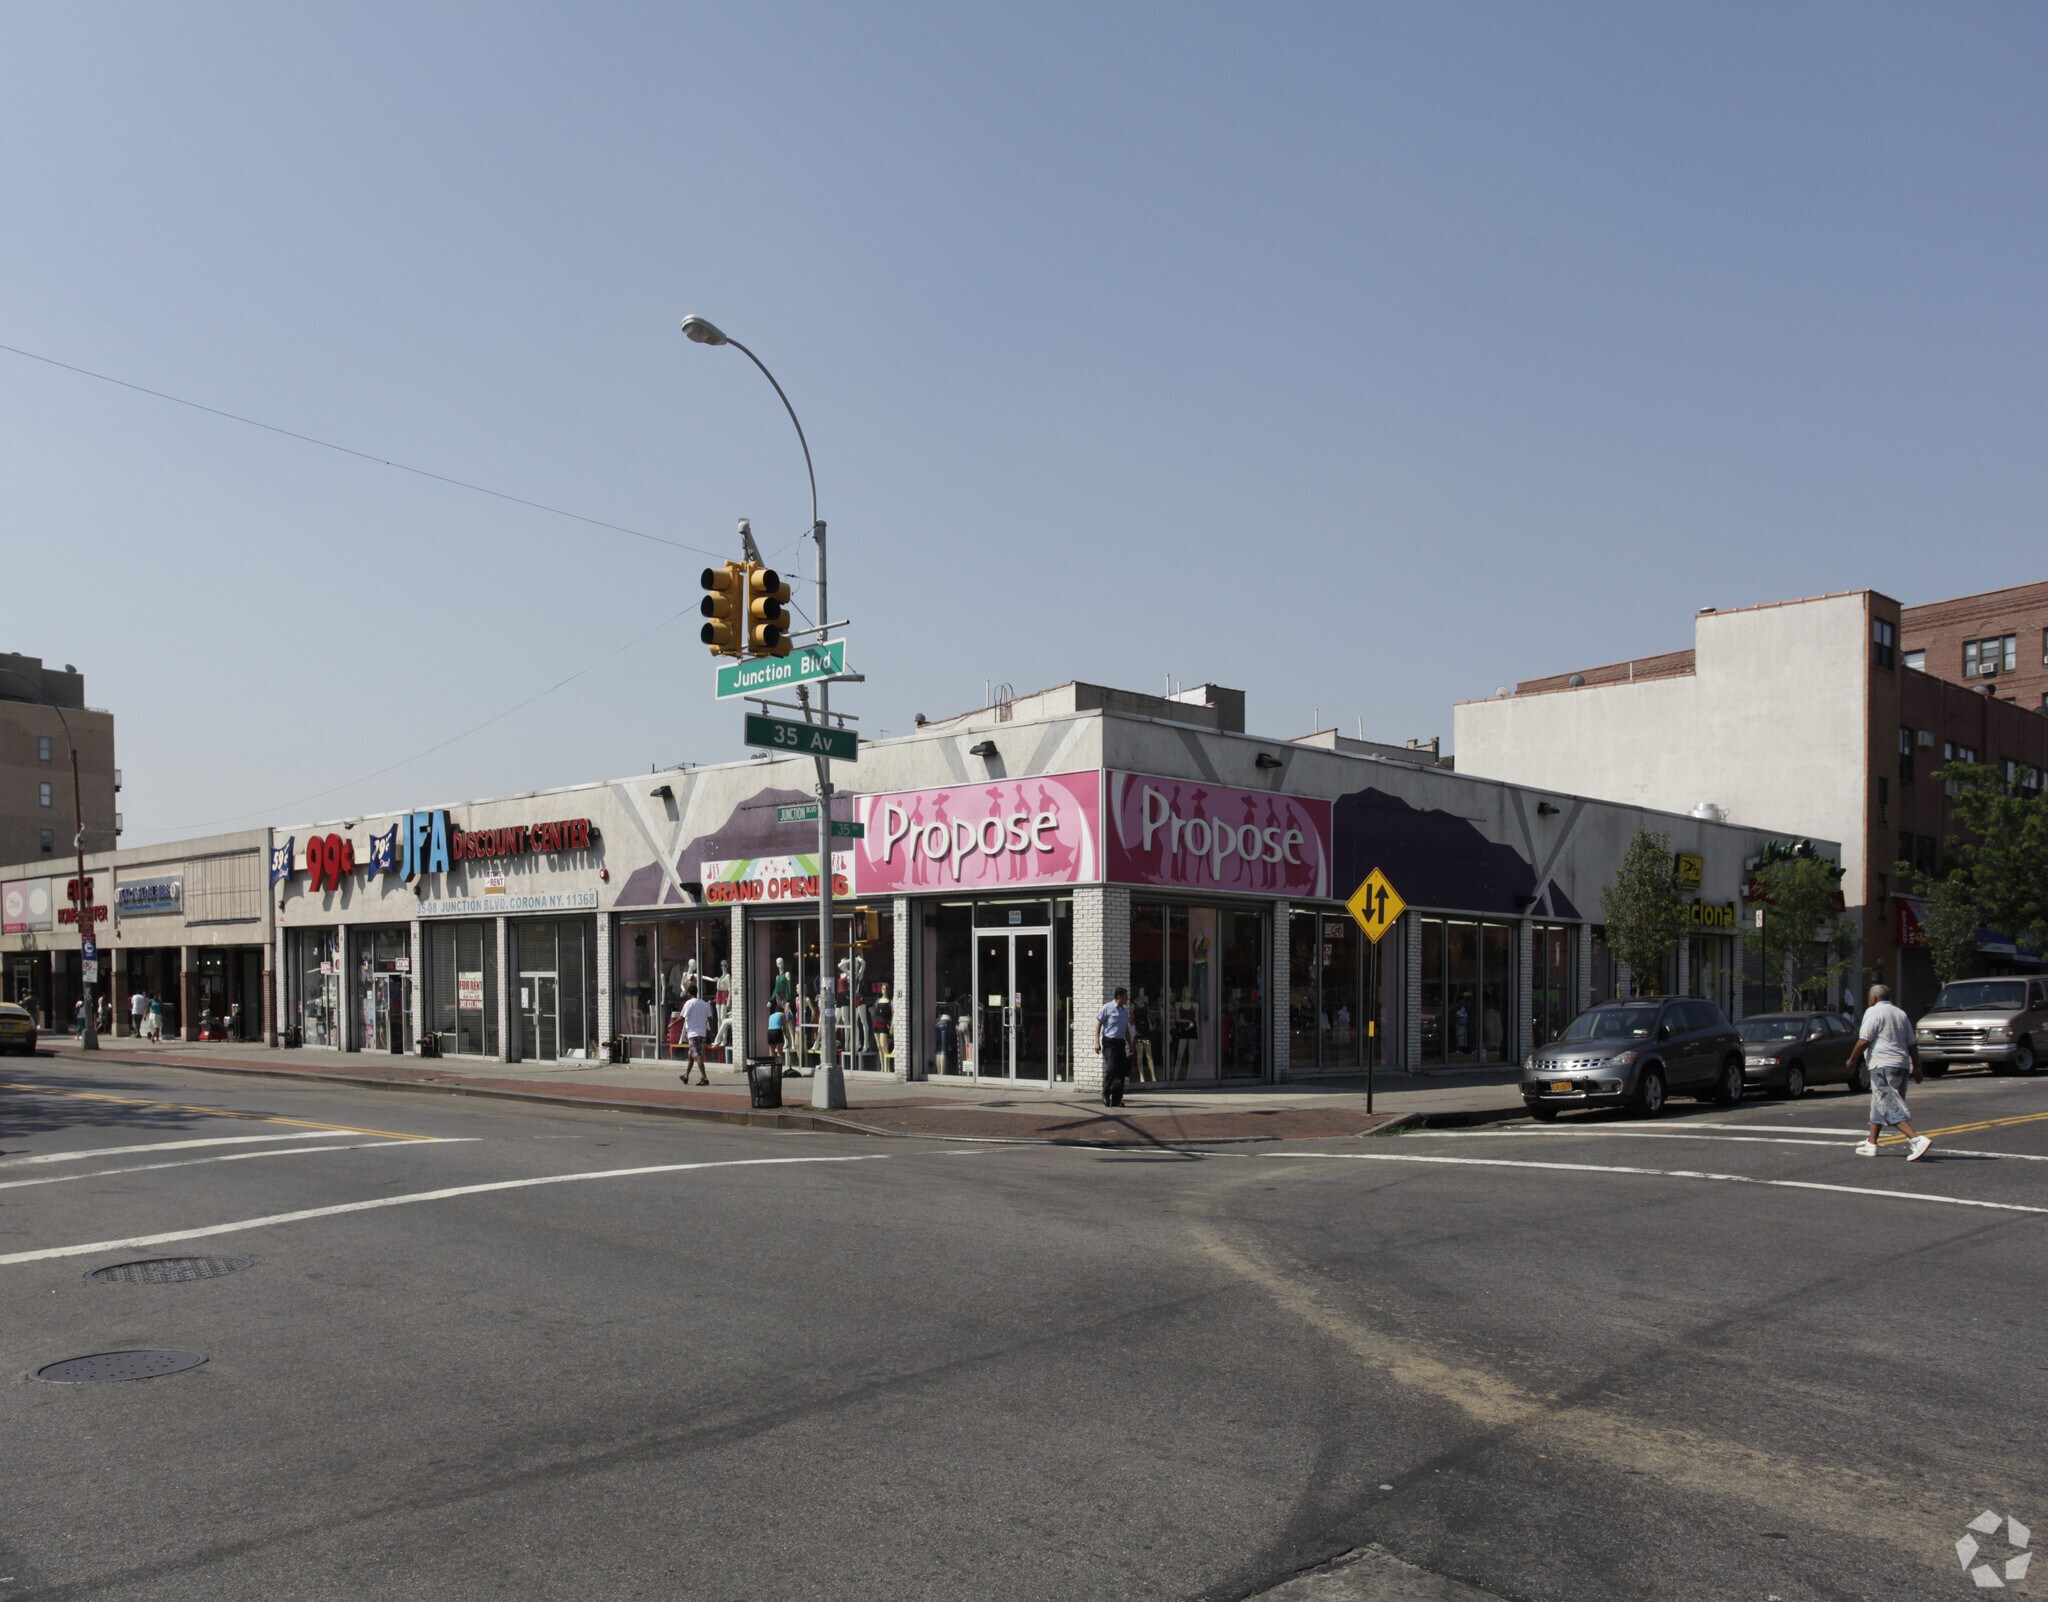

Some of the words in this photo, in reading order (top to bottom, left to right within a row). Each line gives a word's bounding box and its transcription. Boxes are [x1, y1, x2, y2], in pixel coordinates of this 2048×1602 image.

[733, 663, 792, 688] Junction
[800, 651, 831, 675] Blvd
[773, 725, 798, 746] 35
[810, 732, 833, 751] Av
[780, 808, 806, 822] JUNCTION
[805, 806, 817, 814] BLVD
[837, 823, 851, 836] 35
[400, 809, 450, 882] JFA
[452, 826, 527, 861] DISCOUNT
[530, 817, 592, 853] CENTER
[883, 801, 1059, 880] Propose
[1142, 784, 1305, 881] Propose
[416, 902, 438, 915] 35-08
[440, 899, 482, 913] JUNCTION
[509, 895, 548, 909] CORONA
[566, 892, 596, 906] 11368
[706, 880, 764, 903] GRAND
